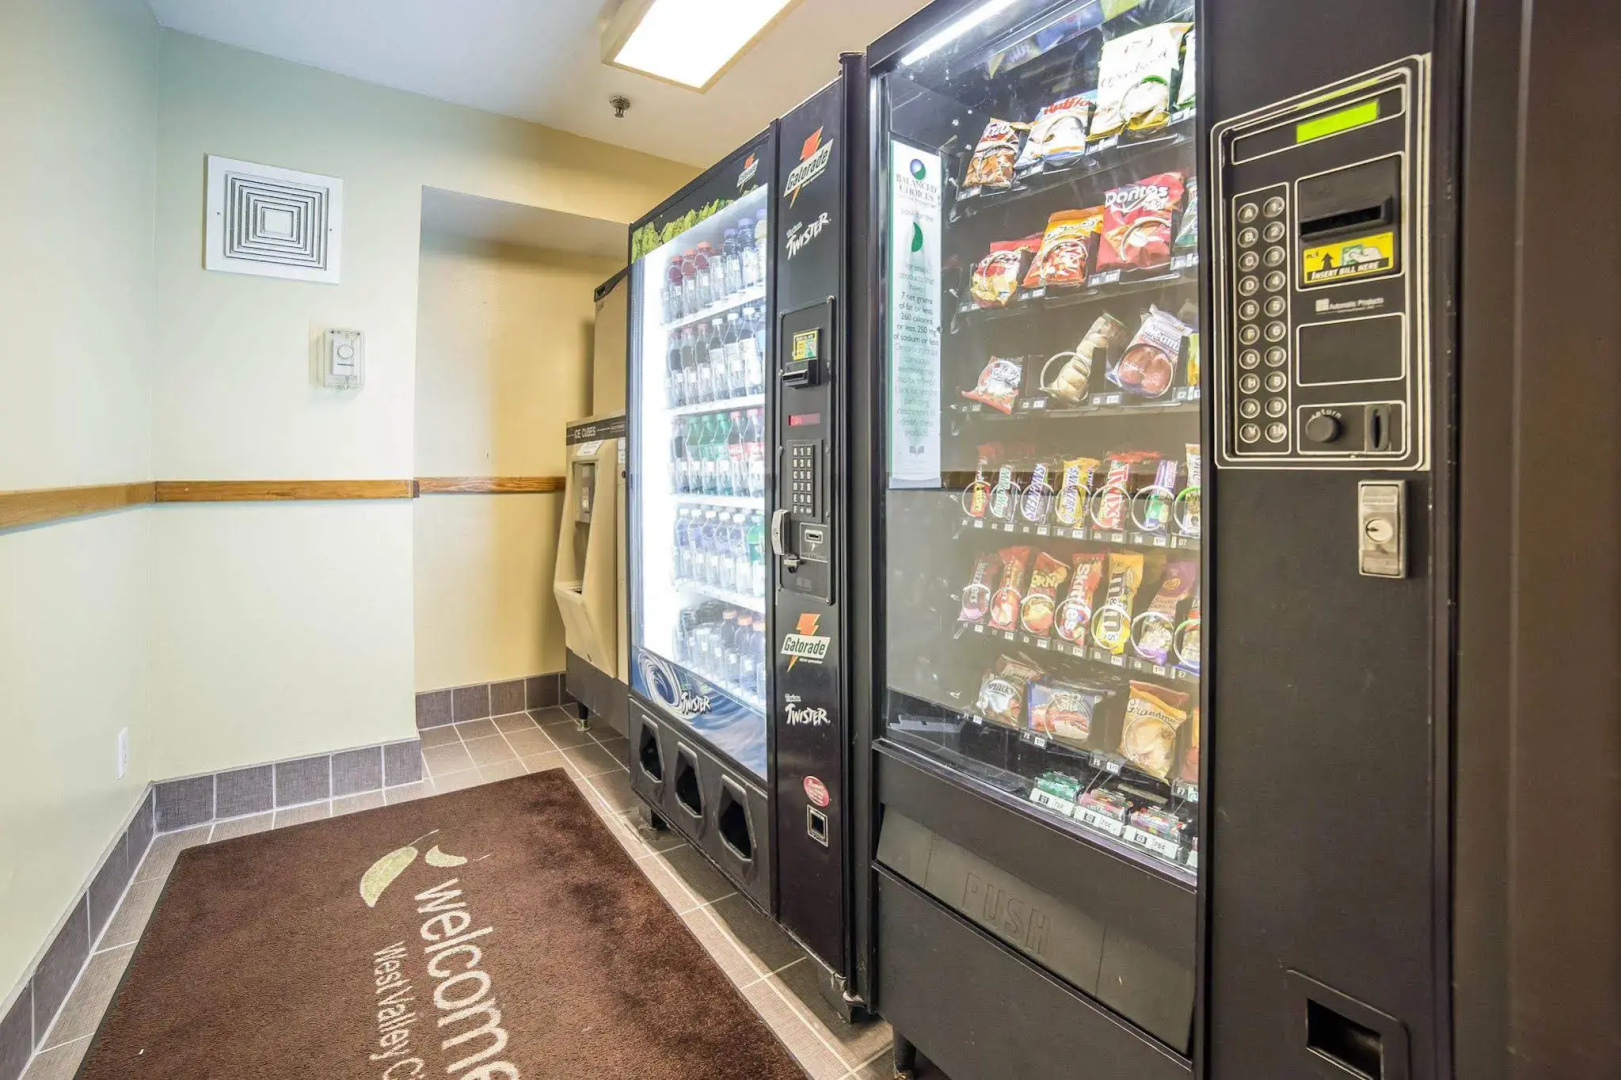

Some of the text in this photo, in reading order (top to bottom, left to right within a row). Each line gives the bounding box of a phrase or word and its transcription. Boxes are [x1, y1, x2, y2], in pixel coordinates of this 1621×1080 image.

[787, 150, 829, 190] Gatorade
[1104, 185, 1169, 208] Doritos
[1244, 208, 1253, 218] A
[1244, 232, 1253, 242] B
[1271, 226, 1278, 236] 2
[1311, 261, 1380, 280] INSERT BILL HERE
[913, 315, 933, 325] calories
[1273, 325, 1280, 335] 6
[1273, 350, 1281, 360] 7
[1247, 378, 1256, 388] H
[1273, 376, 1281, 386] 8
[1274, 401, 1281, 411] 9
[582, 426, 596, 438] CUBES
[1024, 464, 1046, 520] SNICKERS
[1105, 463, 1129, 518] Twix
[784, 637, 826, 656] Gatorade
[681, 692, 712, 715] TWISTER
[785, 703, 830, 726] TWISTER
[962, 872, 1049, 955] PUSH
[373, 940, 408, 995] West
[369, 985, 418, 1060] Valley
